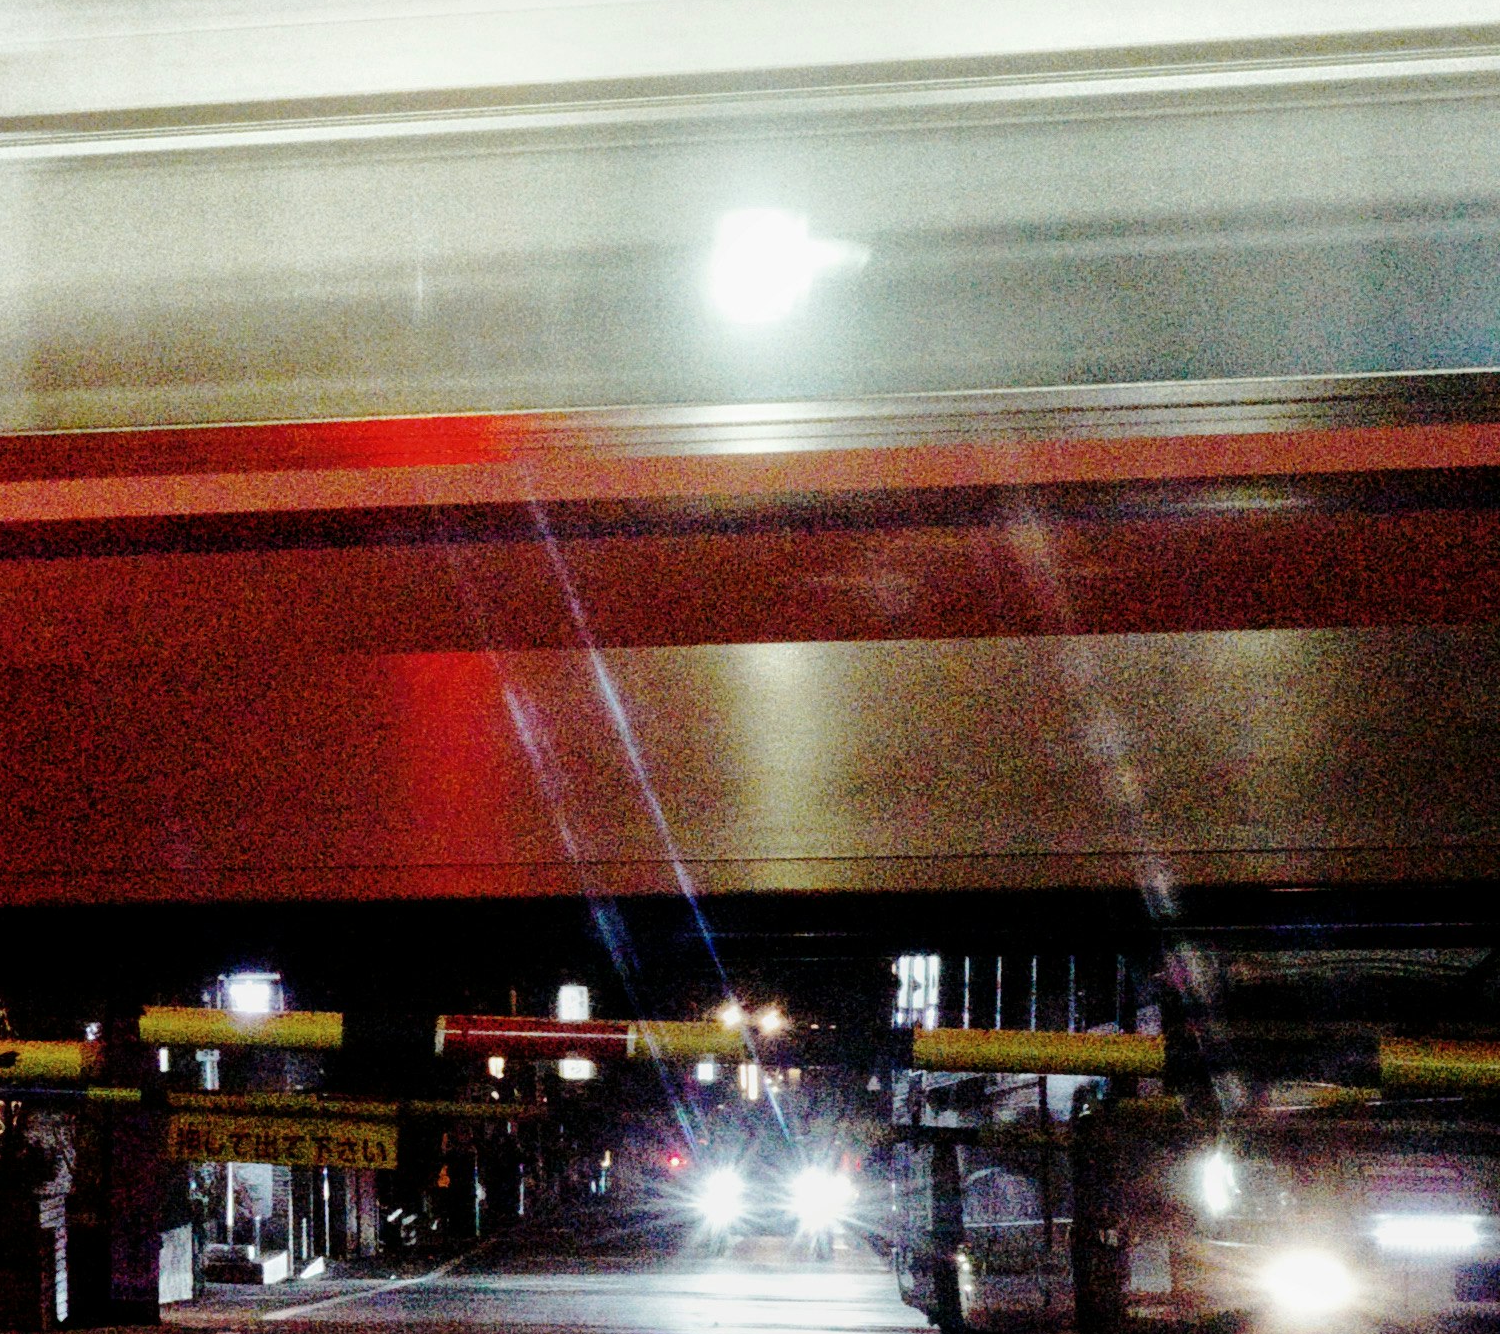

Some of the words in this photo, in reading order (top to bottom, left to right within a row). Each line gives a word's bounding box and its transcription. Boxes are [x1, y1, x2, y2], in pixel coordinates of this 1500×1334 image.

[176, 1121, 388, 1162] 押して出て下さい
